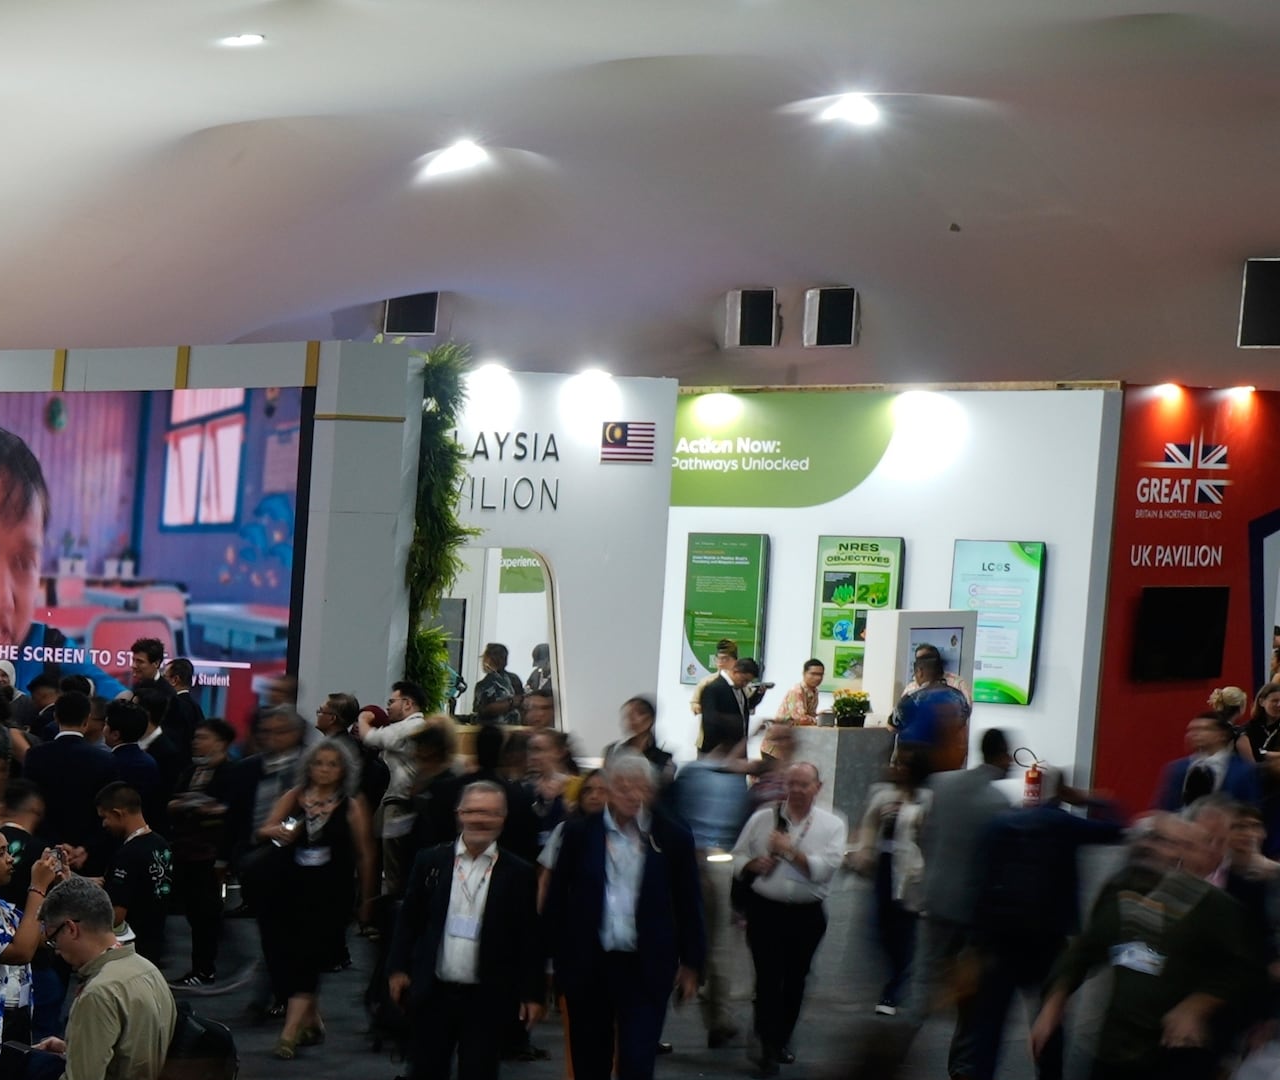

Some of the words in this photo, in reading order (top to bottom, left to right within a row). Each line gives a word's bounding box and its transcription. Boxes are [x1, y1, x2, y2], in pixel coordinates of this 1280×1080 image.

[453, 429, 560, 462] LAYSIA
[675, 435, 734, 454] Action
[736, 436, 782, 454] Now:
[671, 456, 739, 473] Pathways
[741, 456, 810, 471] Unlocked
[454, 475, 560, 511] ILION
[1136, 477, 1192, 504] GREAT
[1135, 508, 1158, 519] BRITAIN
[1164, 509, 1196, 520] NORTHERN
[1197, 510, 1222, 520] IRELAND
[838, 542, 880, 552] NRES
[826, 555, 890, 564] OBJECTIVES
[1130, 545, 1152, 567] UK
[1154, 545, 1223, 567] PAVILION
[857, 585, 870, 602] 2
[821, 621, 834, 638] 3
[23, 645, 85, 664] SCREEN
[89, 649, 112, 665] TO
[198, 673, 230, 687] Student
